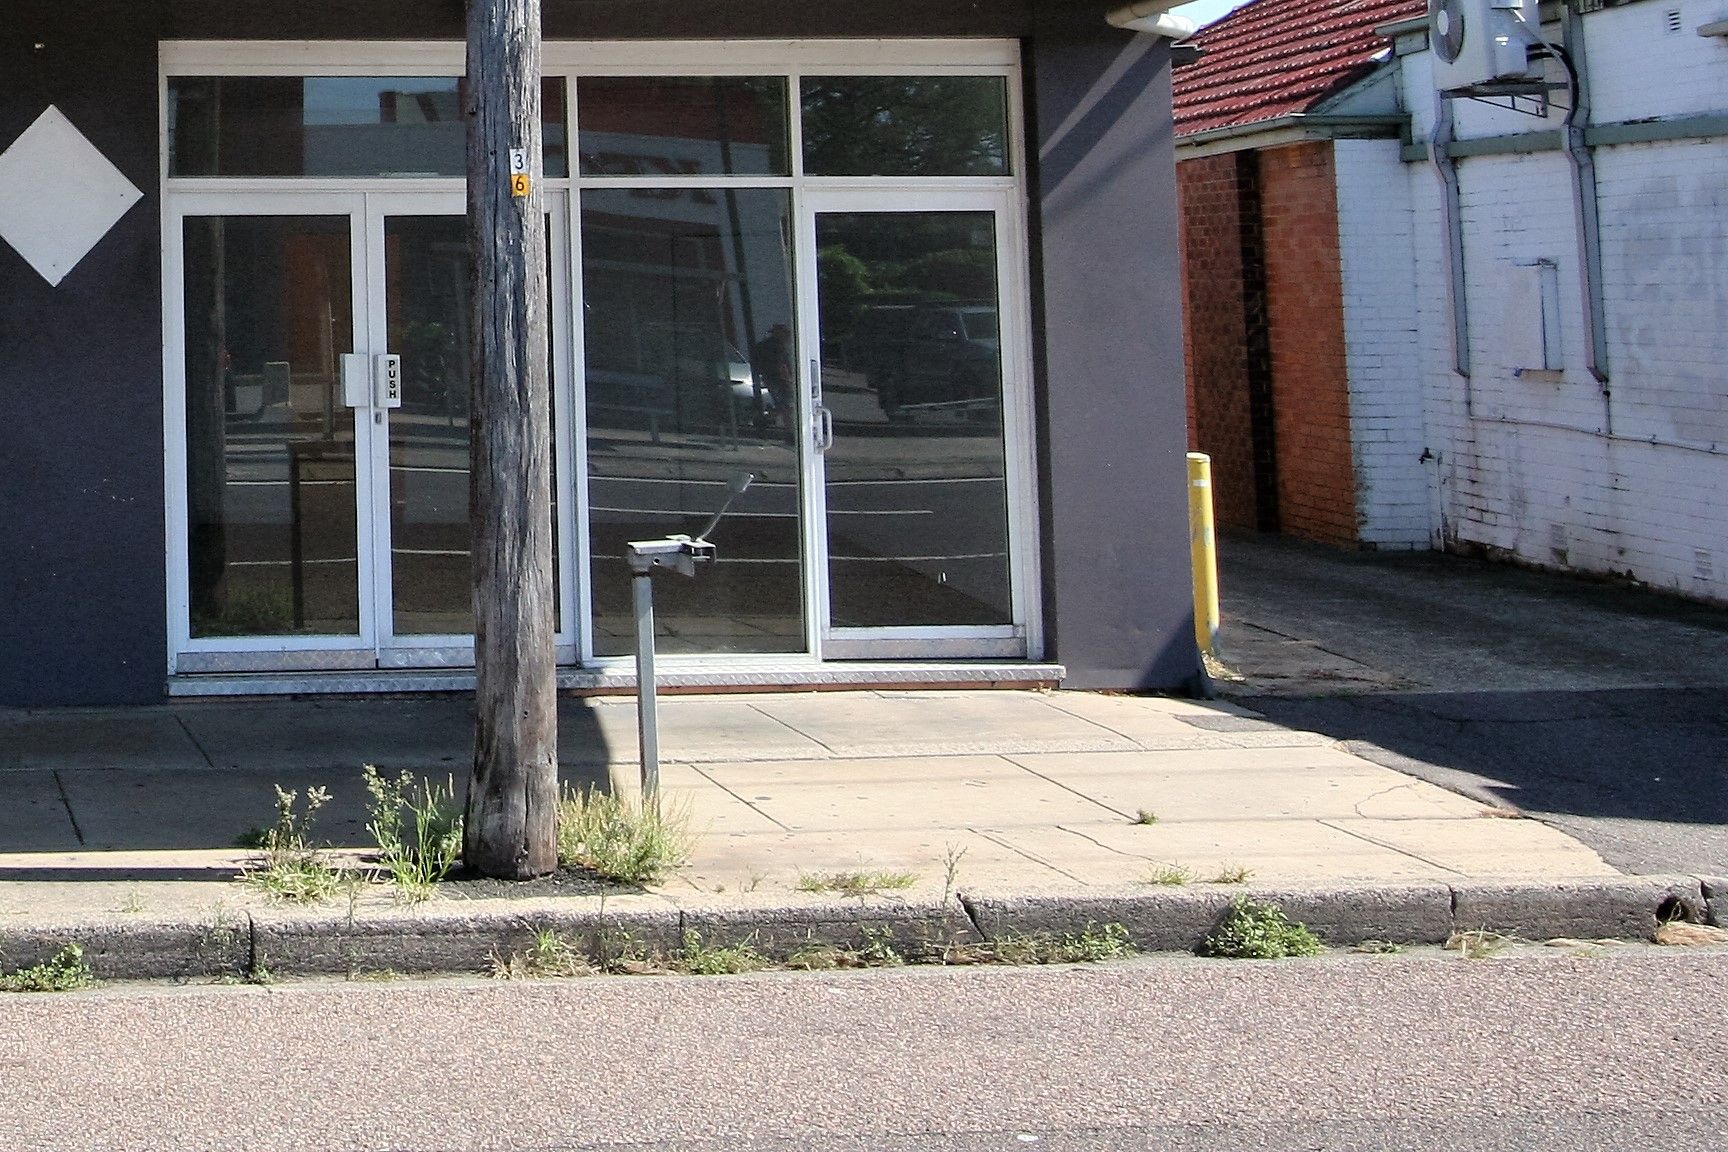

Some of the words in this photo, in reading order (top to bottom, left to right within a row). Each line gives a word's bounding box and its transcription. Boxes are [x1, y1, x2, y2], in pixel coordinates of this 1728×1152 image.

[515, 153, 524, 170] 3
[515, 175, 525, 191] 6
[389, 359, 397, 398] PUSH
